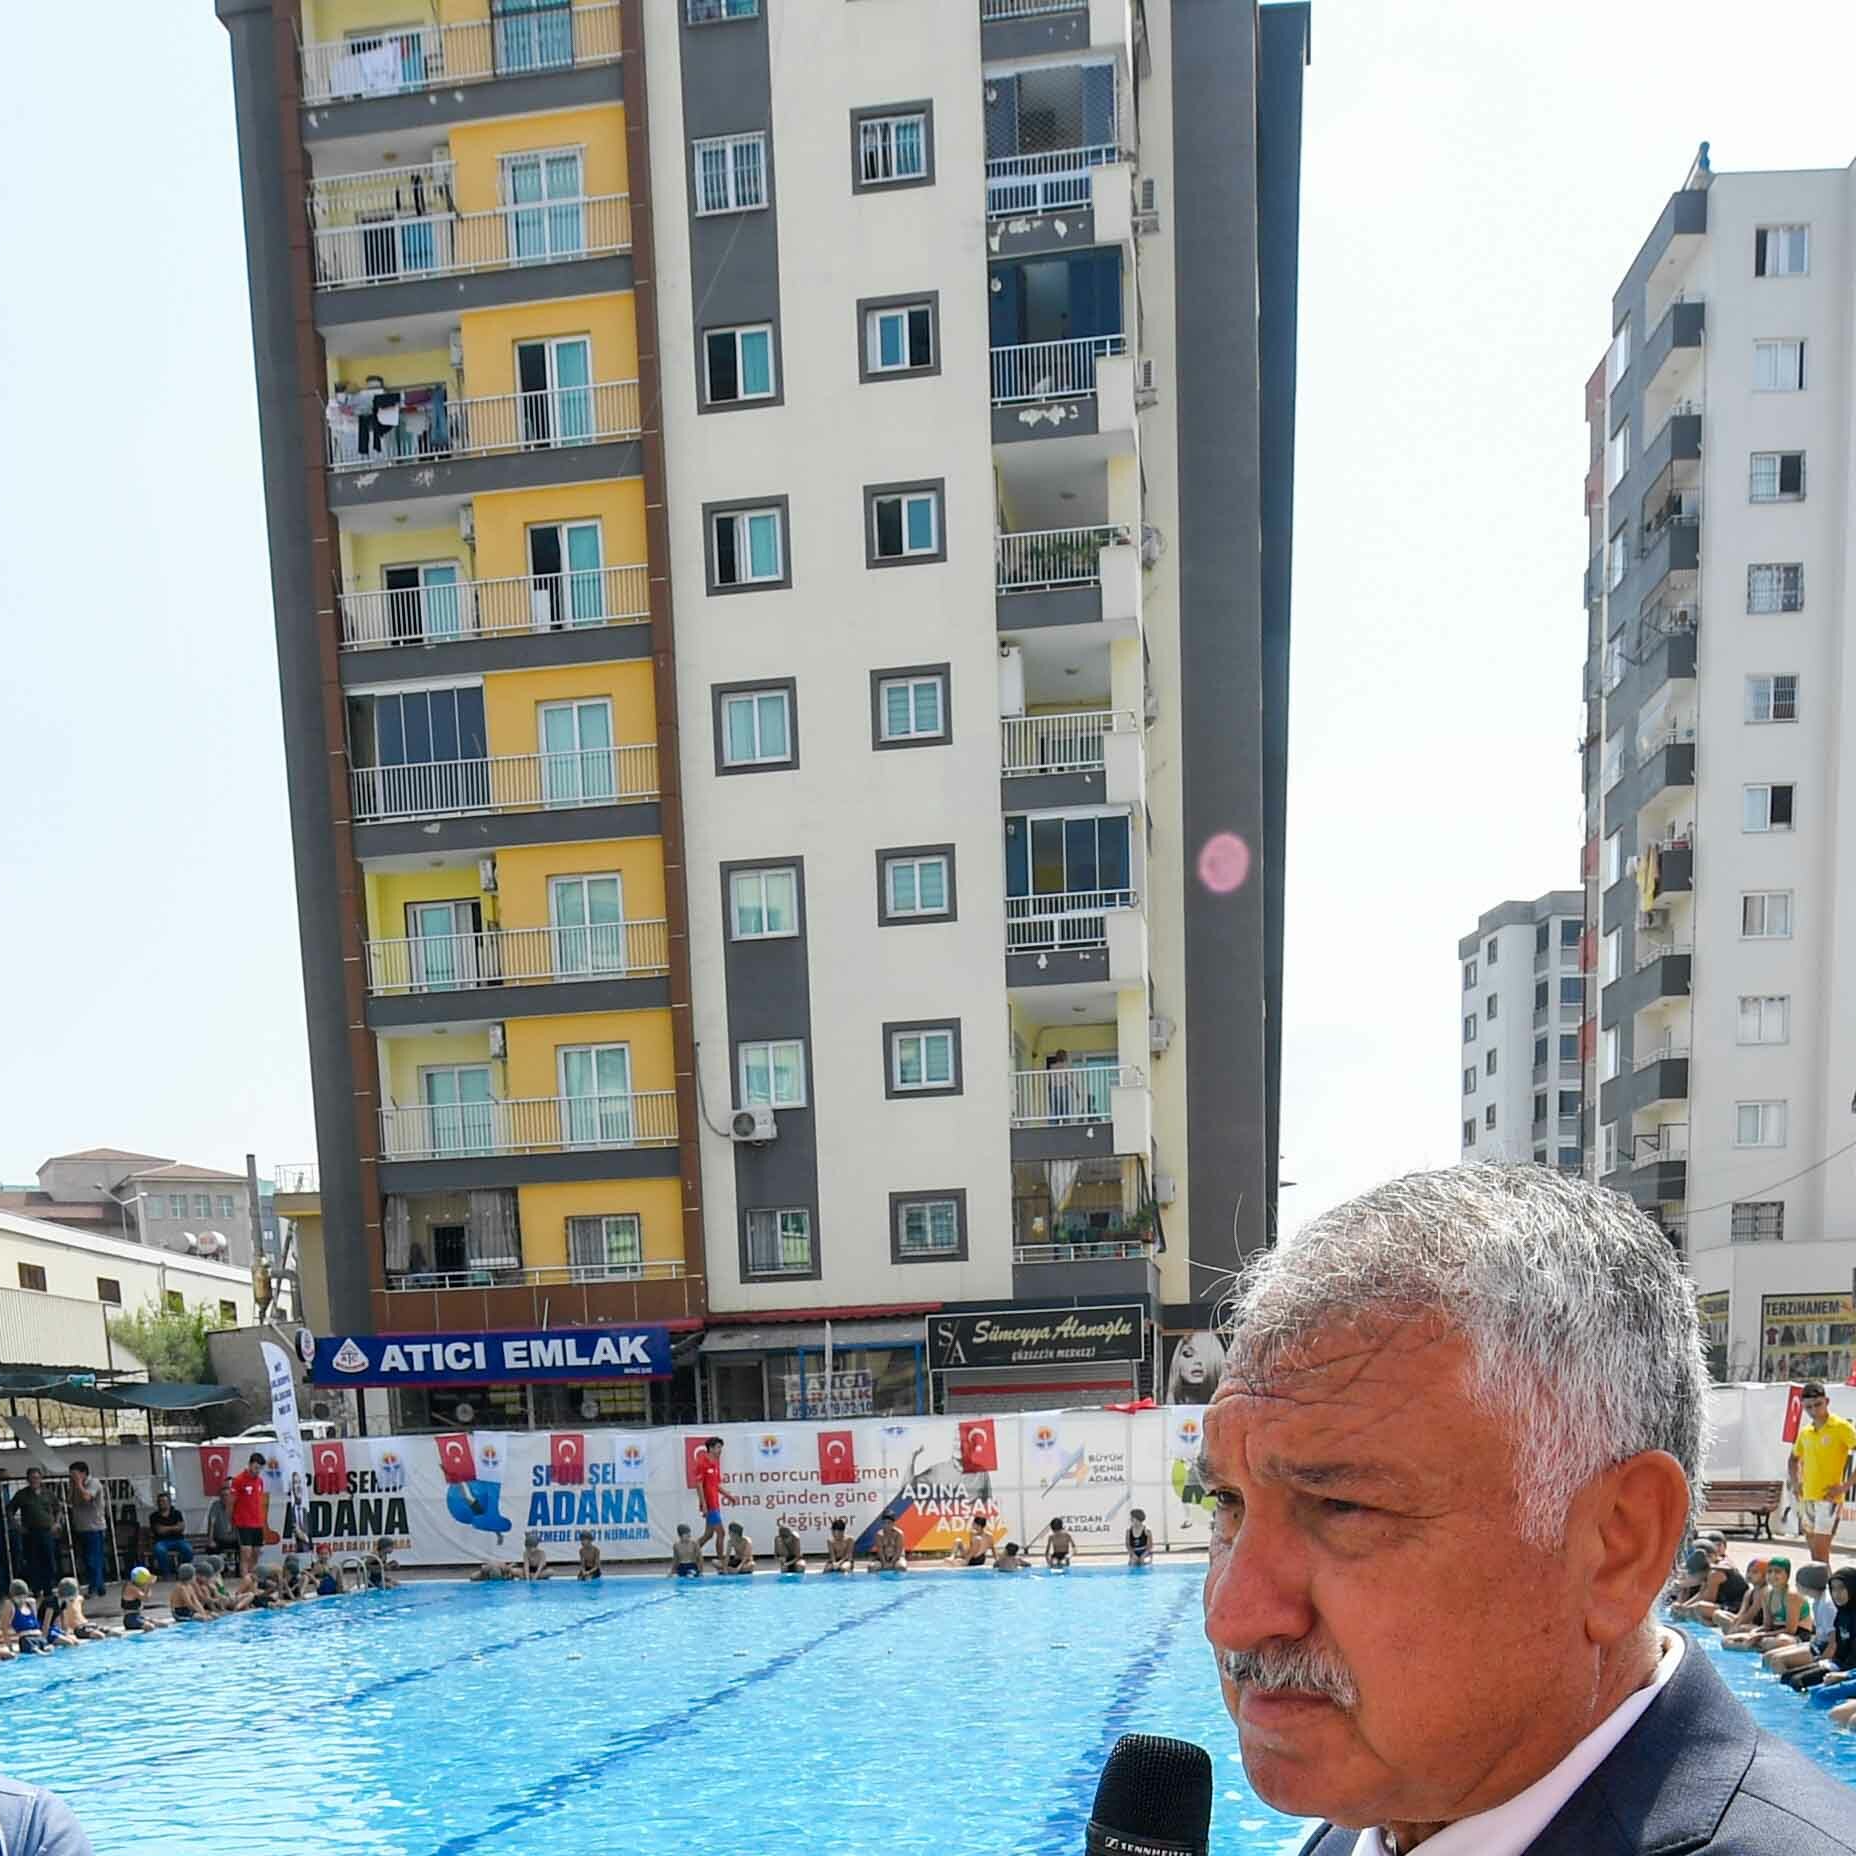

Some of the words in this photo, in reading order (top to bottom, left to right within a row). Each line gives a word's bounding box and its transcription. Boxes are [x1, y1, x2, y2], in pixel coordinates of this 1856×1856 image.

[380, 1341, 486, 1372] ATICI
[504, 1335, 652, 1369] EMLAK
[765, 1488, 831, 1510] günden
[835, 1487, 878, 1508] güne
[902, 1482, 969, 1500] ADINA
[527, 1487, 649, 1527] ADANA
[913, 1497, 1001, 1521] YAKIŞAN
